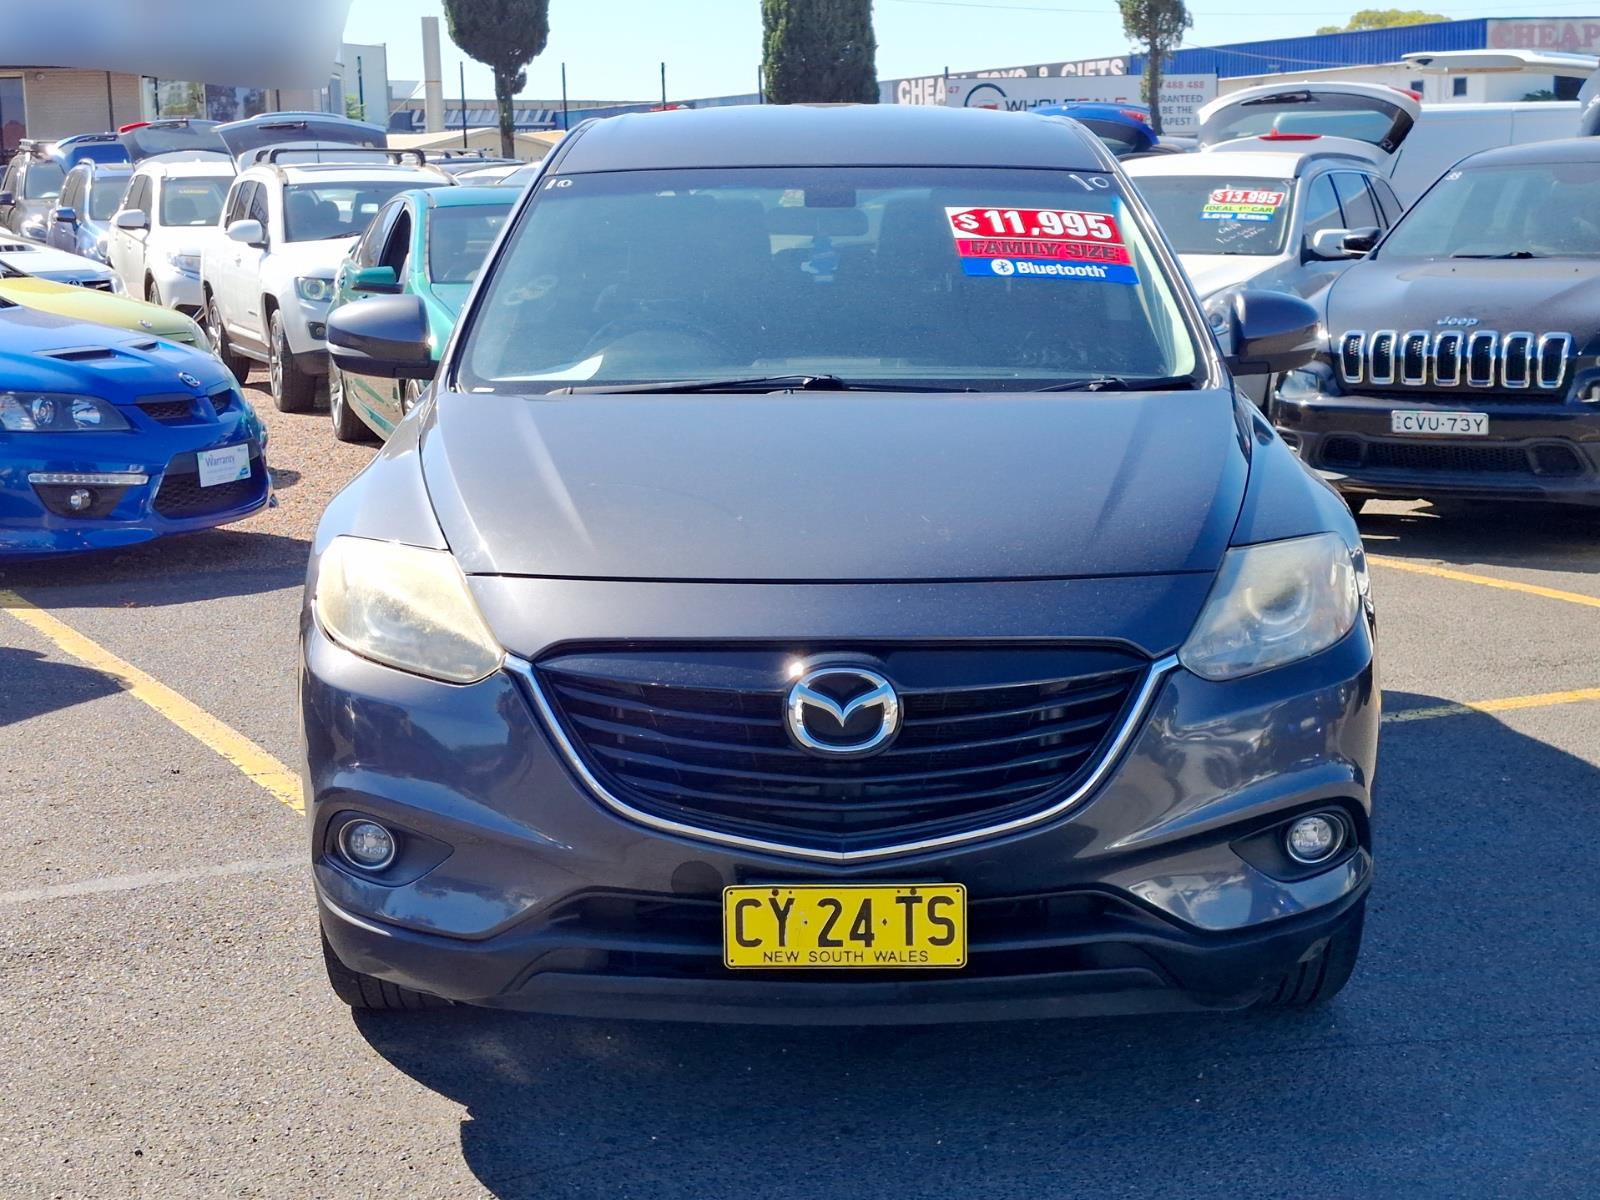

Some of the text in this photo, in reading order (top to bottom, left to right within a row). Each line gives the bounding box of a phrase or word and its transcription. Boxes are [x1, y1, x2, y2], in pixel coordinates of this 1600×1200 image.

[1159, 94, 1204, 103] RANTEED
[1176, 106, 1193, 114] THE
[1162, 117, 1192, 126] APEST
[958, 210, 1112, 239] $11,995
[972, 240, 1059, 257] FAMILY
[1015, 260, 1107, 278] Bluetooth
[1436, 315, 1479, 327] Jeep
[763, 950, 929, 963] NEW SOUTH WALES
